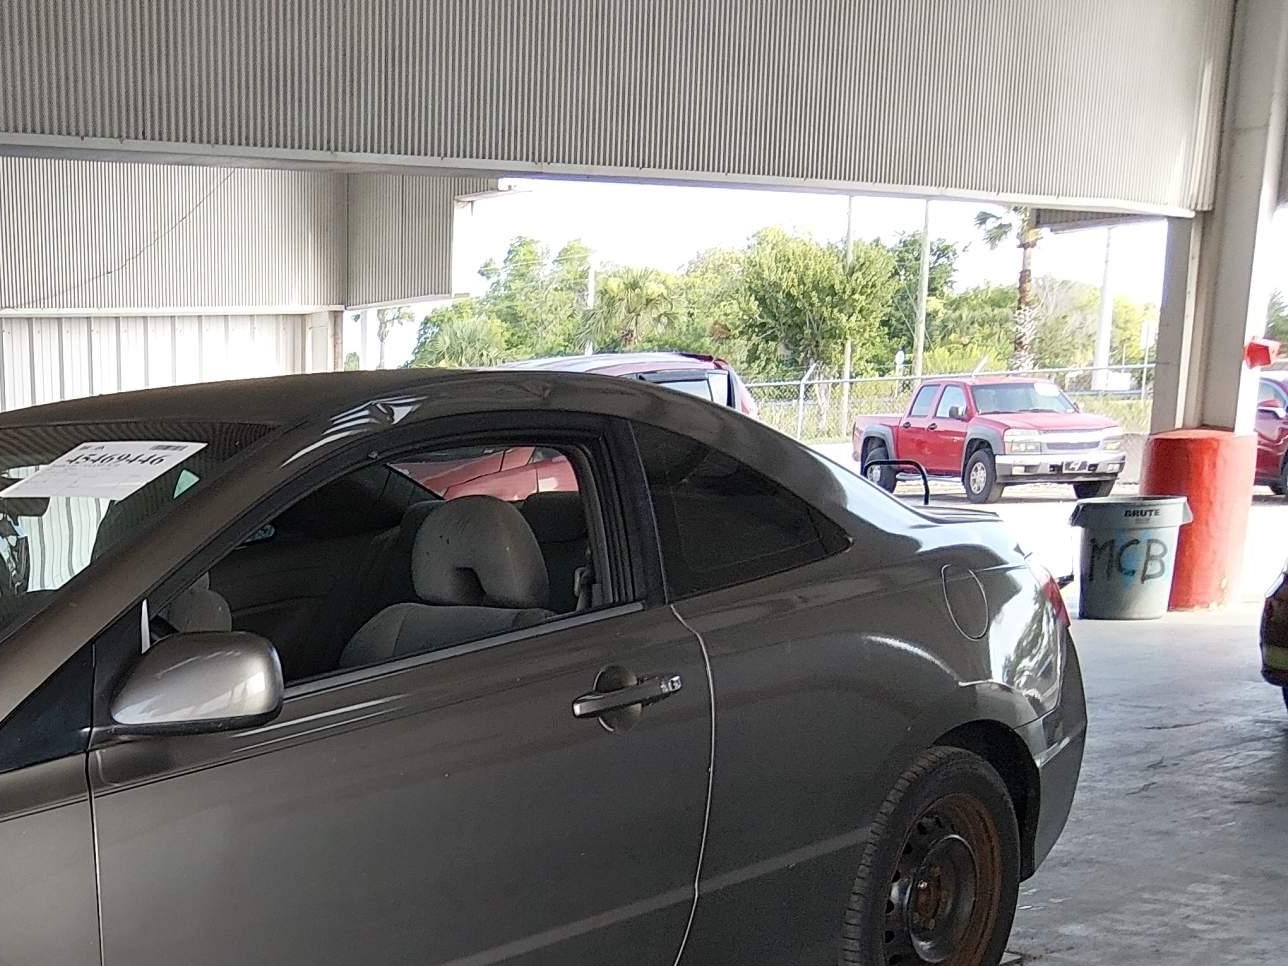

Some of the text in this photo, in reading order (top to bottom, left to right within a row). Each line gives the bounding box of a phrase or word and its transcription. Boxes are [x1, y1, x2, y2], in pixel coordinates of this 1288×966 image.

[66, 453, 166, 465] 45469446
[1123, 508, 1161, 518] BRUTE
[1088, 538, 1169, 585] MCB
